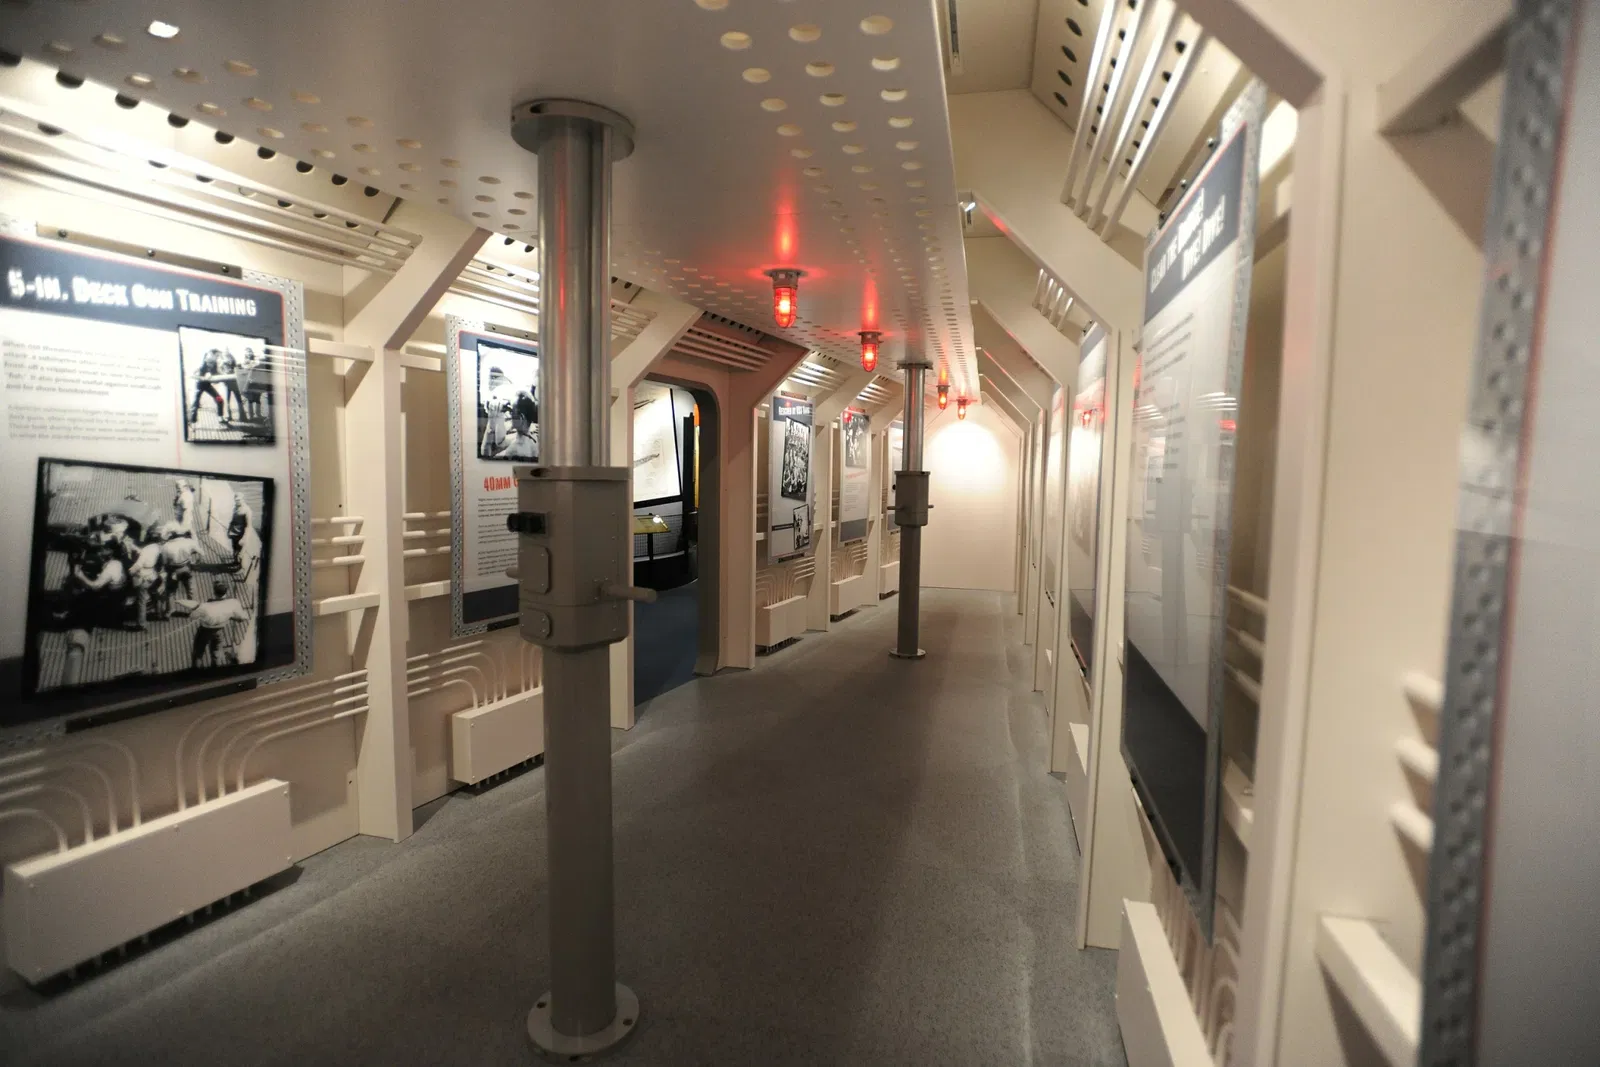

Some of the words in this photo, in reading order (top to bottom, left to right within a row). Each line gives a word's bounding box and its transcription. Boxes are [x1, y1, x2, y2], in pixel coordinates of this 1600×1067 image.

[72, 275, 129, 306] DECK
[175, 288, 257, 317] TRAINING
[484, 476, 511, 492] 40MM
